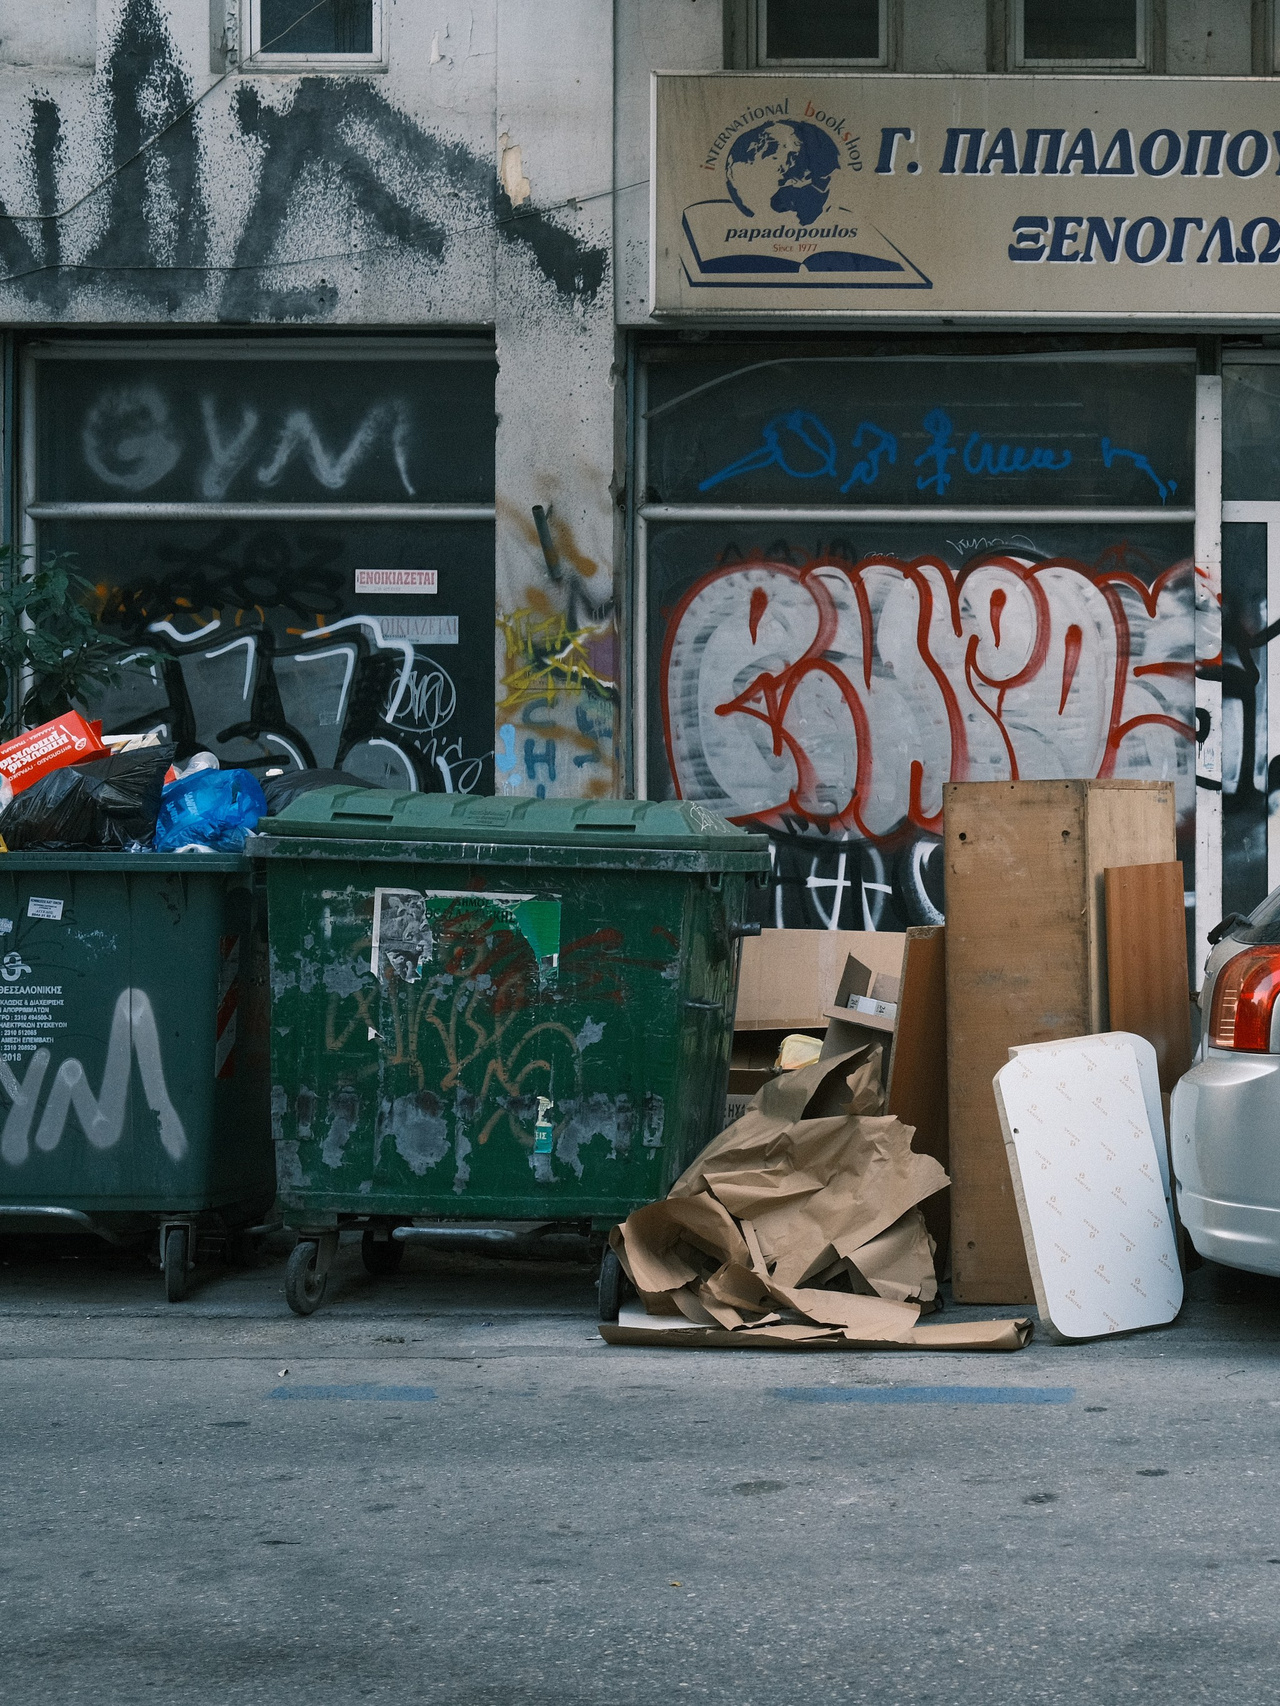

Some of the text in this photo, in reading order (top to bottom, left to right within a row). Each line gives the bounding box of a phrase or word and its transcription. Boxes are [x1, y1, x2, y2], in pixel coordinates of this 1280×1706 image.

[874, 127, 922, 176] Γ.
[724, 225, 858, 242] papadopoulos
[798, 244, 818, 253] 1977
[359, 571, 435, 586] ΕΝΟΙΚΙΑΖΕΤΑΙ
[7, 734, 69, 774] μπουκιά
[2, 1053, 22, 1061] 2018
